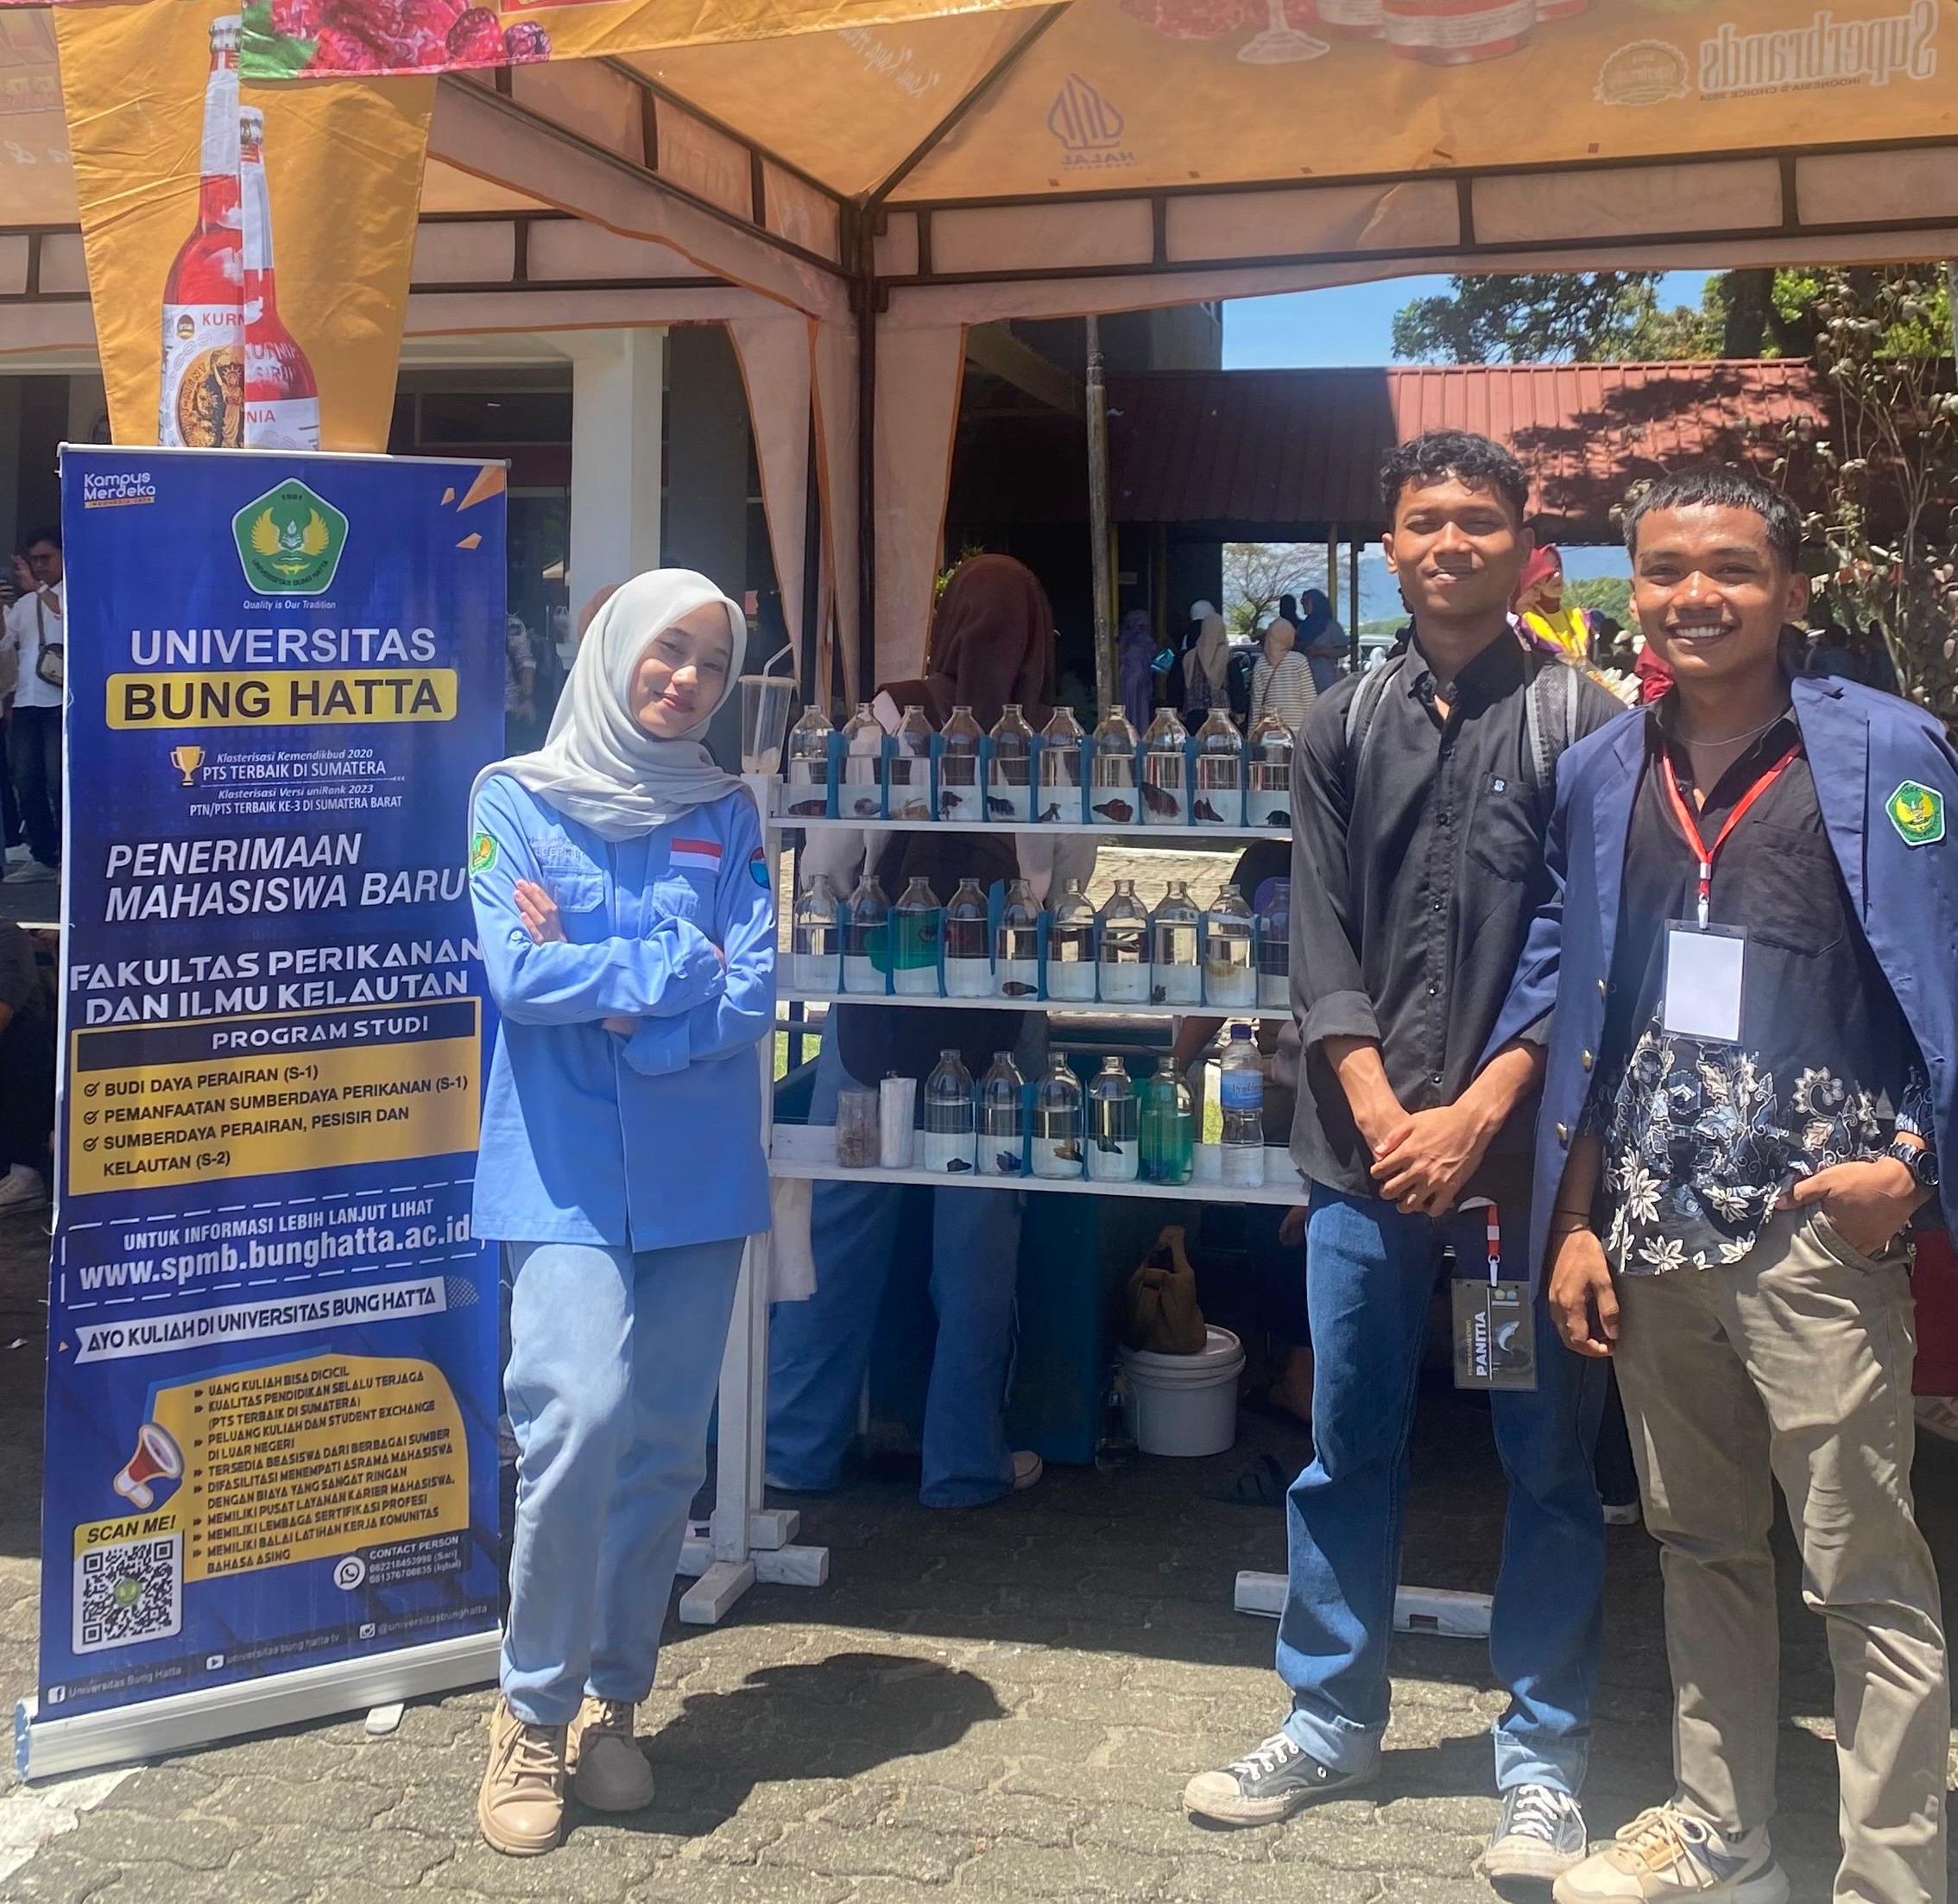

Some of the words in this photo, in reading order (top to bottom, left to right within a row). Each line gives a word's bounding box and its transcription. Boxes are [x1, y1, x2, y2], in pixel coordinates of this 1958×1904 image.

[84, 472, 151, 487] Kampus
[84, 484, 155, 501] Merdeka
[243, 600, 273, 611] Quality
[275, 600, 282, 610] is
[284, 600, 300, 610] Our
[302, 600, 336, 610] Tradition
[131, 628, 436, 665] UNIVERSITAS
[124, 681, 270, 721] BUNG
[290, 678, 442, 716] HATTA
[203, 765, 227, 781] PTS
[231, 763, 289, 781] TERBAIK
[293, 763, 307, 777] DI
[311, 760, 387, 777] SUMATERA
[217, 750, 275, 763] Klasterisasi
[277, 749, 345, 762] Kemendikbud
[347, 749, 373, 759] 2020
[190, 803, 232, 818] PTN/PTS
[235, 801, 276, 814] TERBAIK
[278, 800, 300, 812] KE-3
[302, 800, 313, 812] DI
[315, 797, 369, 812] SUMATERA
[370, 795, 402, 808] BARAT
[218, 787, 276, 800] Klasterisasi
[279, 786, 305, 797] Versi
[306, 785, 345, 796] uniRank
[347, 784, 374, 794] 2023
[105, 833, 362, 879] PENERIMAAN
[104, 874, 349, 922] MAHASISWA
[359, 867, 467, 906] BARU
[69, 953, 259, 991] FAKULTAS
[268, 938, 483, 977] PERIKANAN
[86, 993, 168, 1025] DAN
[179, 985, 268, 1017] ILMU
[277, 970, 468, 1009] KELAUTAN
[212, 1022, 346, 1050] PROGRAM
[353, 1015, 428, 1038] STUDI
[104, 1079, 145, 1097] BUDI
[150, 1075, 193, 1094] DAYA
[197, 1067, 278, 1090] PERAIRAN
[284, 1064, 319, 1083] (S-1)
[104, 1098, 225, 1124] PEMANFAATAN
[230, 1088, 338, 1113] SUMBERDAYA
[343, 1079, 432, 1102] PERIKANAN
[436, 1075, 468, 1093] (S-1)
[104, 1125, 216, 1150] SUMBERDAYA
[221, 1116, 307, 1139] PERAIRAN,
[311, 1110, 372, 1130] PESISIR
[376, 1106, 409, 1124] DAN
[104, 1154, 191, 1177] KELAUTAN
[196, 1150, 231, 1170] (S-2)
[124, 1228, 180, 1251] UNTUK
[185, 1217, 273, 1244] INFORMASI
[279, 1211, 324, 1234] LEBIH
[329, 1204, 386, 1229] LANJUT
[391, 1198, 434, 1222] LIHAT
[79, 1213, 471, 1290] www.spmb.bunghatta.ac.id
[87, 1327, 124, 1352] AYO
[129, 1318, 194, 1346] KULIAH
[197, 1315, 215, 1338] DI
[218, 1300, 330, 1334] UNIVERSITAS
[333, 1294, 379, 1319] BUNG
[383, 1286, 436, 1312] HATTA
[1475, 1311, 1487, 1376] PANITIA
[209, 1381, 239, 1396] UANG
[242, 1375, 282, 1391] KULIAH
[284, 1371, 308, 1385] BISA
[312, 1366, 350, 1381] DICICIL
[209, 1393, 262, 1412] KUALITAS
[264, 1383, 330, 1404] PENDIDIKAN
[332, 1377, 373, 1394] SELALU
[376, 1370, 424, 1388] TERJAGA
[208, 1426, 260, 1445] PELUANG
[263, 1420, 301, 1437] KULIAH
[305, 1416, 326, 1431] DAN
[329, 1408, 376, 1427] STUDENT
[379, 1400, 435, 1420] EXCHANGE
[209, 1413, 234, 1431] (PTS
[237, 1406, 285, 1424] TERBAIK
[287, 1404, 298, 1417] DI
[301, 1396, 360, 1416] SUMATERA)
[208, 1449, 218, 1461] DI
[222, 1444, 251, 1459] LUAR
[255, 1438, 294, 1454] NEGERI
[208, 1471, 278, 1493] DIFASILITASI
[281, 1461, 341, 1481] MENEMPATI
[344, 1453, 388, 1471] ASRAMA
[391, 1443, 452, 1464] MAHASISWA
[209, 1458, 262, 1477] TERSEDIA
[266, 1449, 320, 1468] BEASISWA
[324, 1444, 349, 1458] DARI
[351, 1435, 406, 1454] BERBAGAI
[409, 1428, 450, 1445] SUMBER
[208, 1490, 254, 1509] DENGAN
[256, 1485, 287, 1502] BIAYA
[291, 1480, 319, 1496] YANG
[321, 1473, 363, 1490] SANGAT
[366, 1466, 407, 1483] RINGAN
[208, 1506, 257, 1525] MEMILIKI
[260, 1500, 294, 1516] PUSAT
[297, 1491, 346, 1510] LAYANAN
[348, 1484, 388, 1502] KARIER
[87, 1523, 139, 1544] SCAN
[142, 1515, 176, 1535] ME!
[208, 1522, 257, 1540] MEMILIKI
[260, 1513, 312, 1532] LEMBAGA
[314, 1502, 380, 1523] SERTIFIKASI
[382, 1494, 427, 1512] PROFESI
[208, 1538, 257, 1557] MEMILIKI
[260, 1532, 293, 1547] BALAI
[295, 1523, 341, 1541] LATIHAN
[344, 1517, 377, 1533] KERJA
[379, 1507, 439, 1527] KOMUNITAS
[207, 1555, 254, 1573] BAHASA
[256, 1549, 290, 1565] ASING
[369, 1543, 416, 1559] CONTACT
